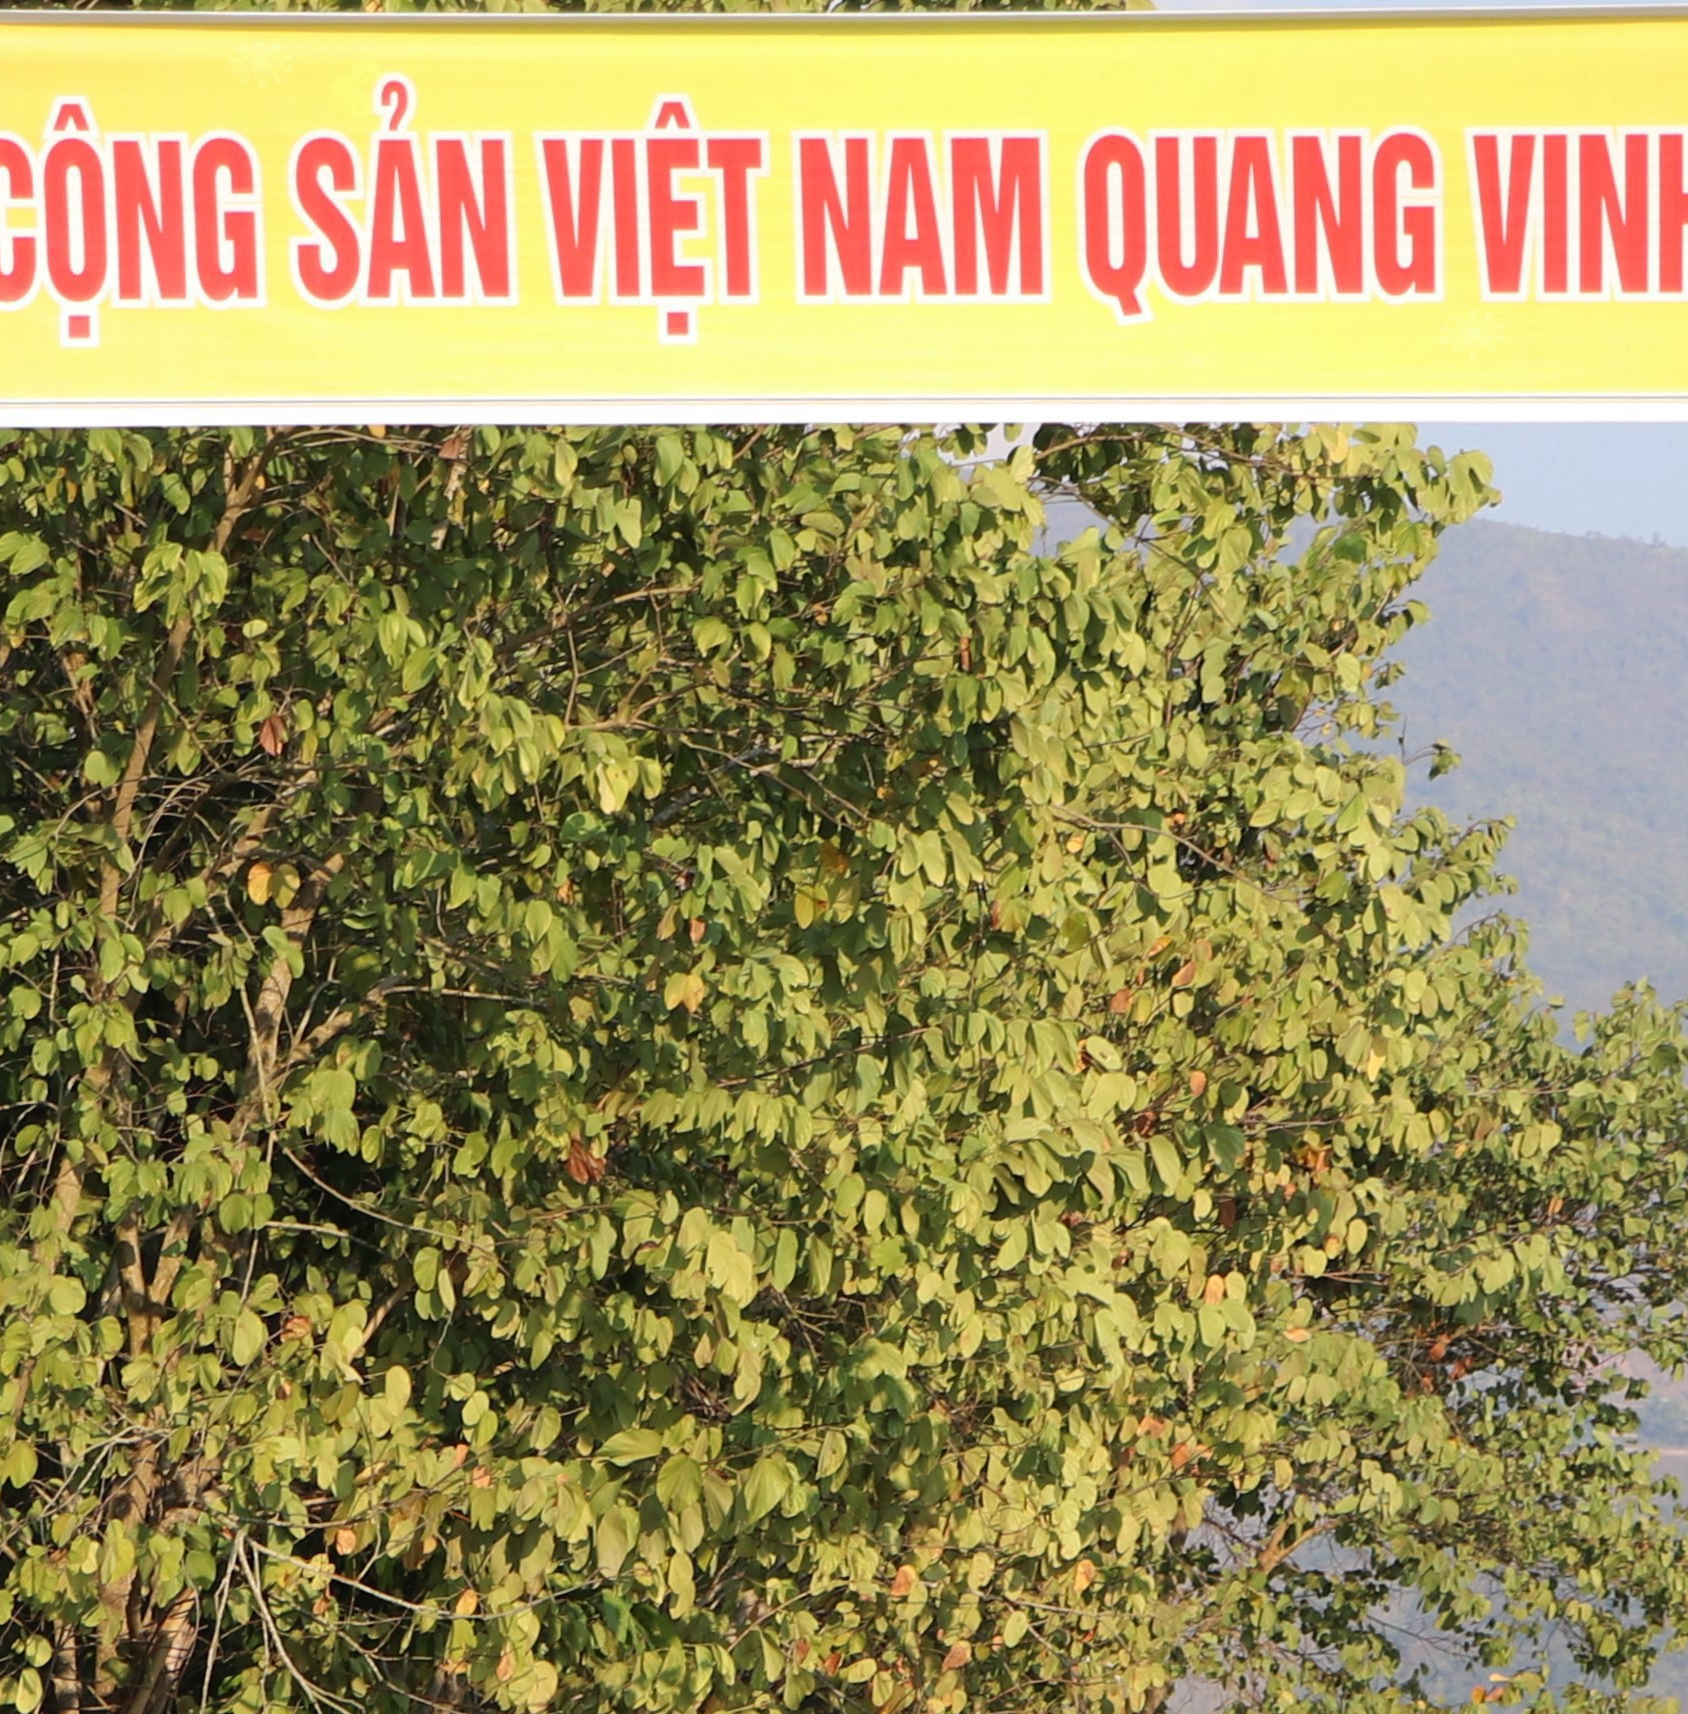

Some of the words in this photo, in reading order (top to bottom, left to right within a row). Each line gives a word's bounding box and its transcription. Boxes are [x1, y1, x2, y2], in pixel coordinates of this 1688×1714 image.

[295, 80, 511, 301] SẢN
[541, 100, 763, 336] VIỆT
[798, 135, 1044, 297] NAM
[1082, 131, 1437, 317] QUANG
